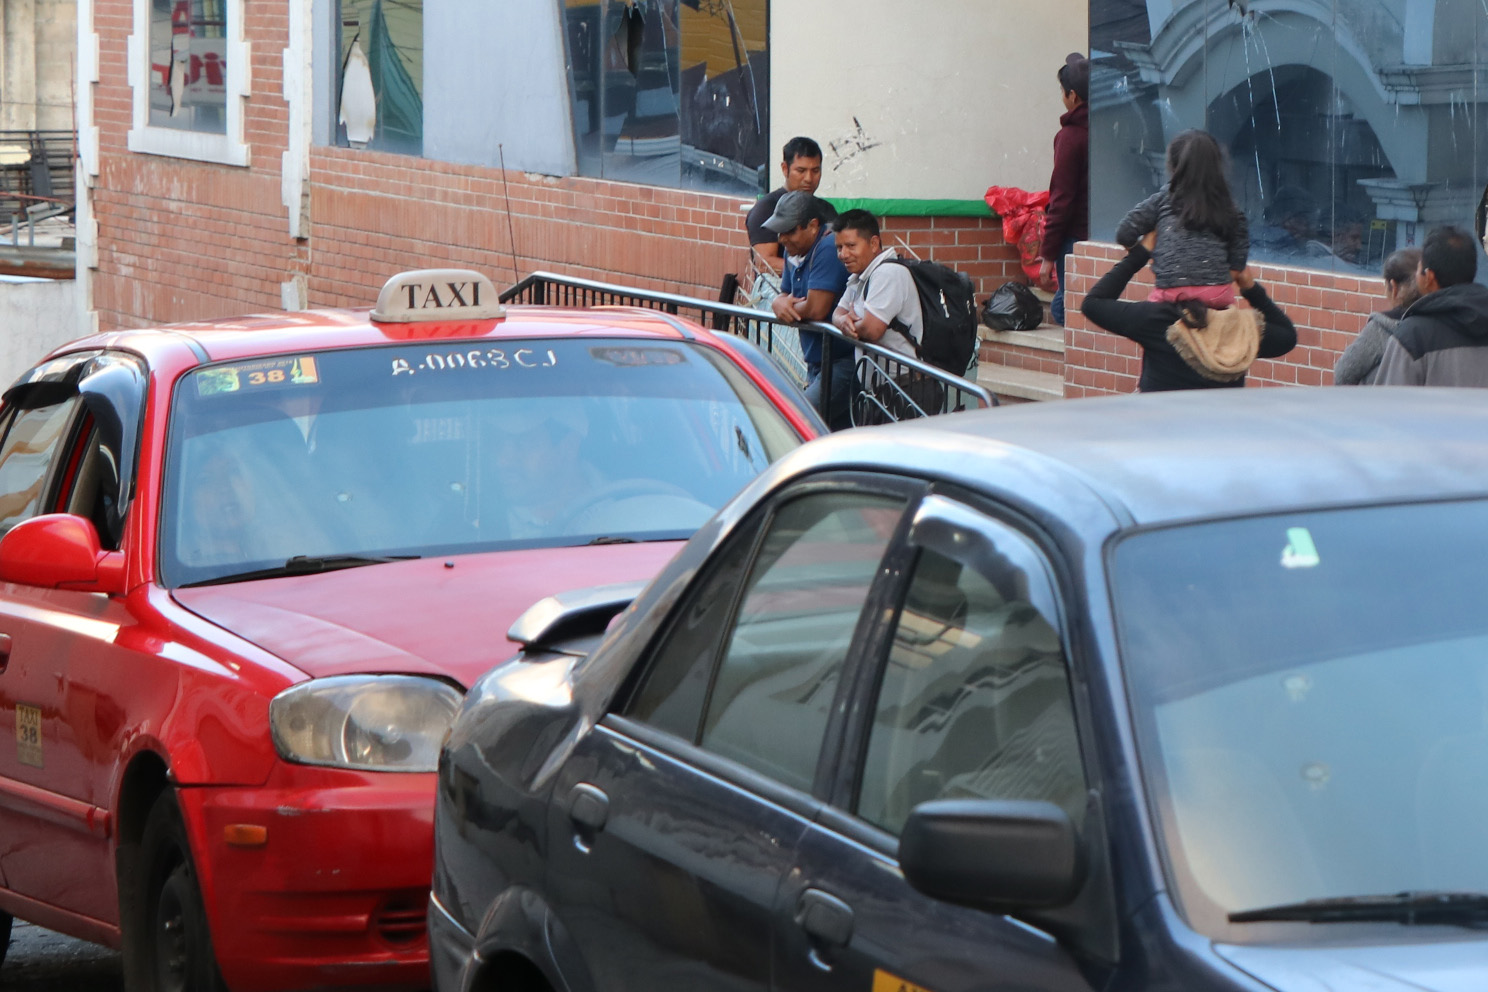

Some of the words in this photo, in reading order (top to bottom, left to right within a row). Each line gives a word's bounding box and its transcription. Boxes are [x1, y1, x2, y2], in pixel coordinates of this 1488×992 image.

[401, 281, 482, 309] TAXI
[248, 369, 286, 385] 38
[19, 724, 38, 745] 38
